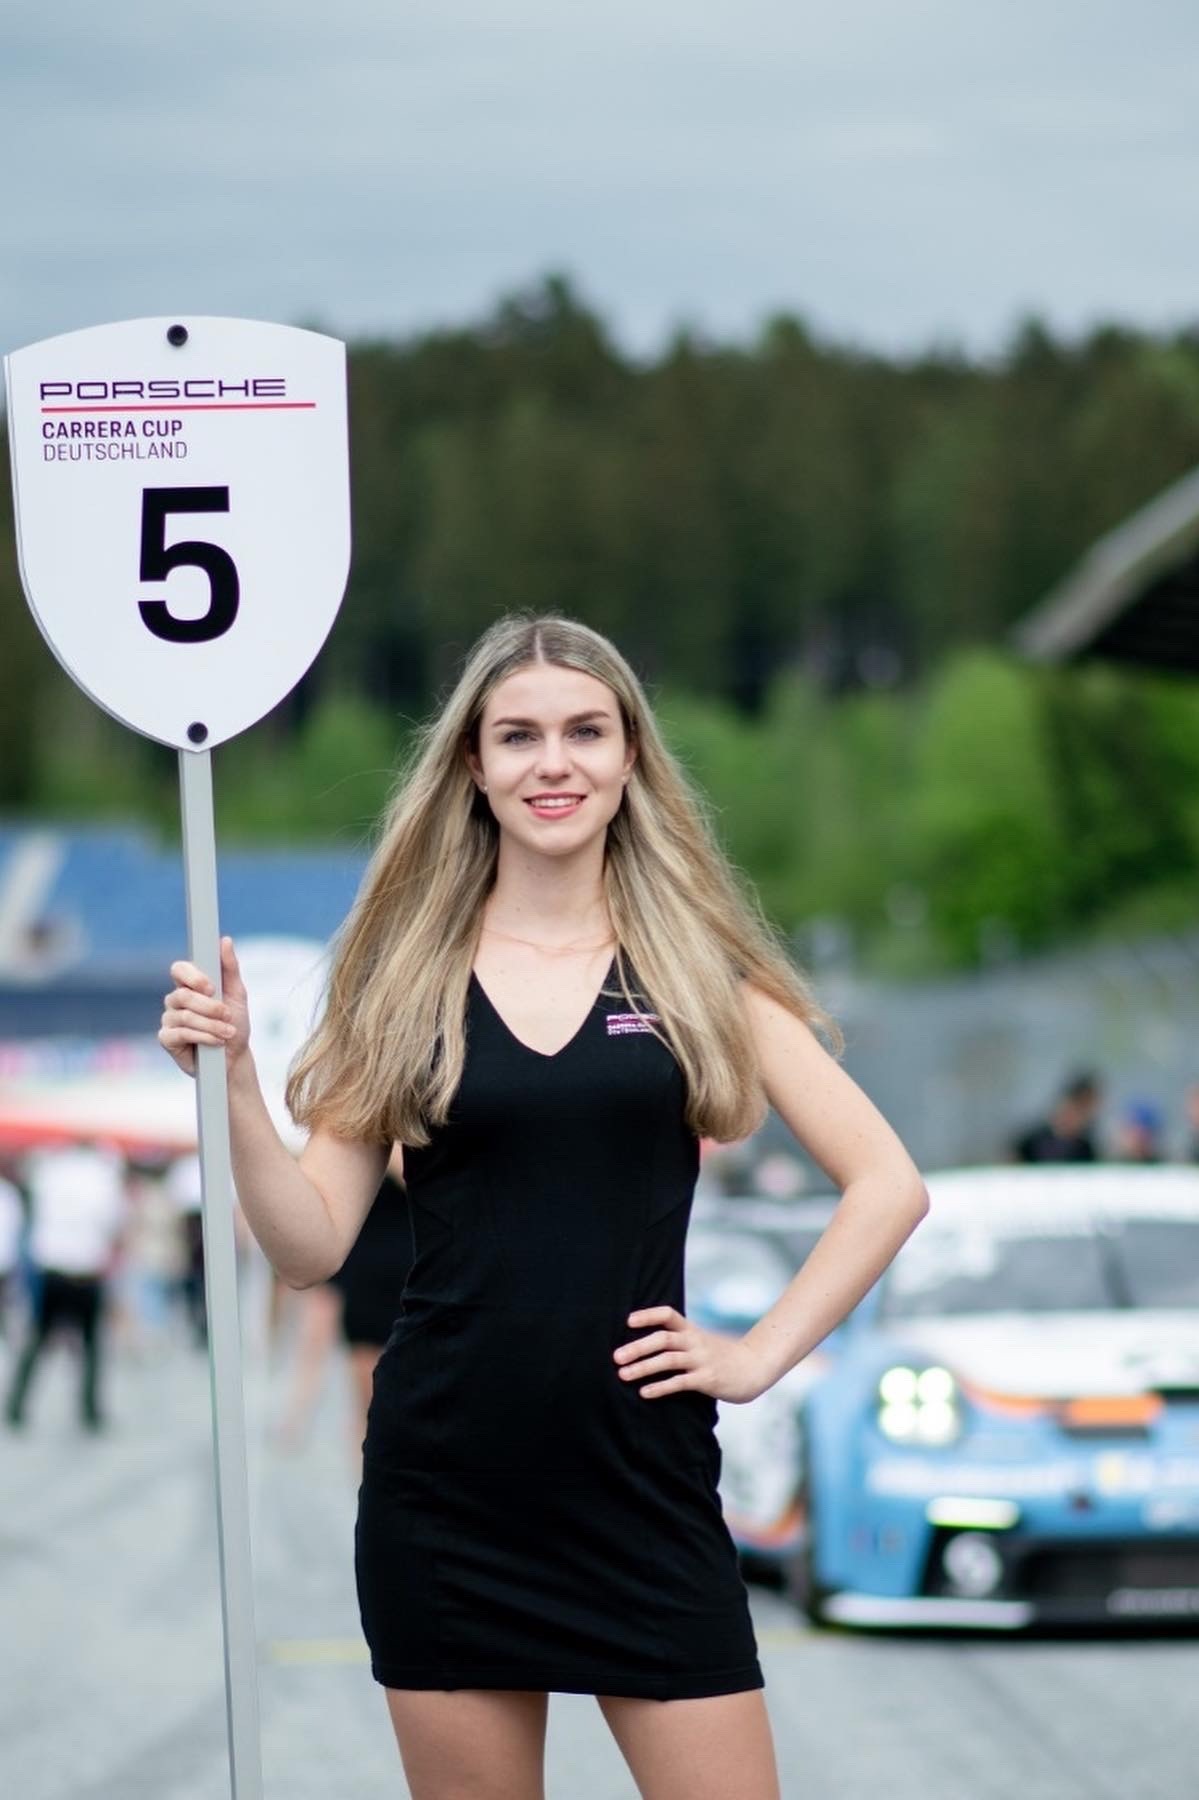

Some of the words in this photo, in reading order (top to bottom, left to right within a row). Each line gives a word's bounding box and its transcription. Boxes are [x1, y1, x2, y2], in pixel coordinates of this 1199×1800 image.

[40, 379, 286, 400] PORSCHE
[42, 420, 137, 439] CARRERA
[142, 420, 183, 437] CUP
[43, 441, 188, 461] DEUTSCHLAND
[138, 486, 240, 644] 5
